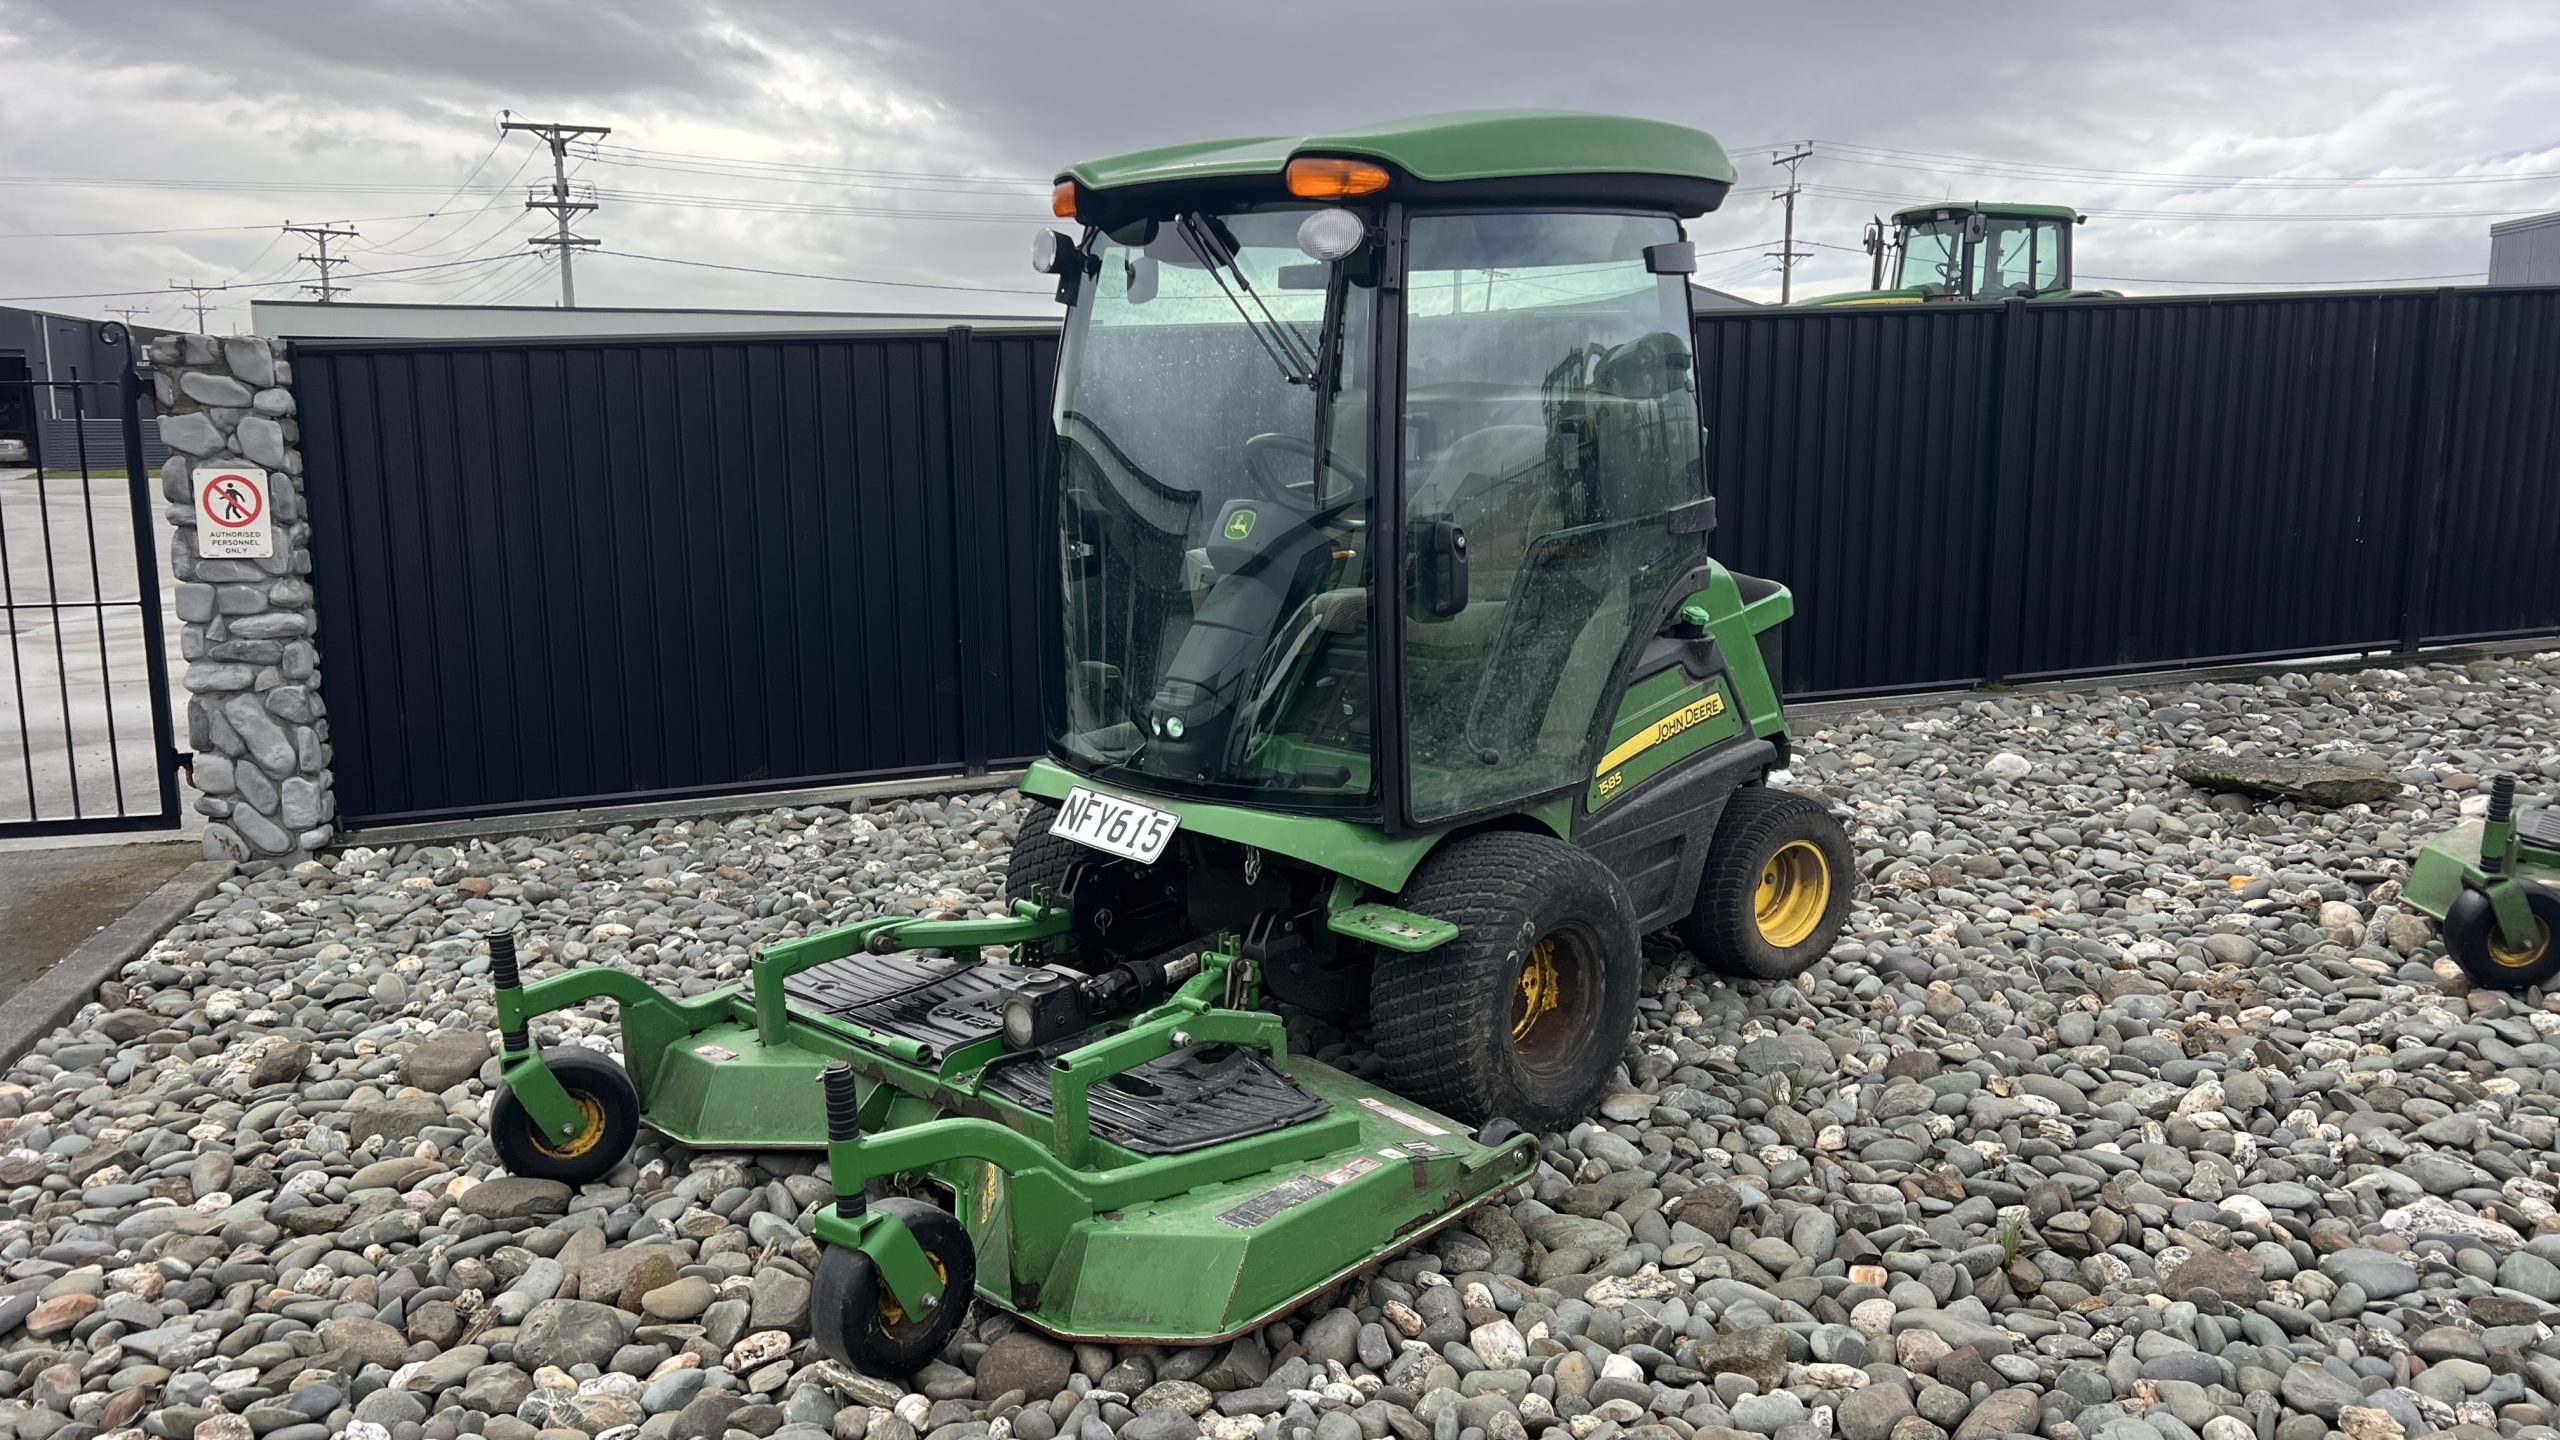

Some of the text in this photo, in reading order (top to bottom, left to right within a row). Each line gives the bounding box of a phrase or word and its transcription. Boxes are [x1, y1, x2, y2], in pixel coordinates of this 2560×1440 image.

[1655, 699, 1719, 743] JOHN DEERE
[1598, 771, 1623, 796] 1585
[1058, 793, 1170, 854] NFY615
